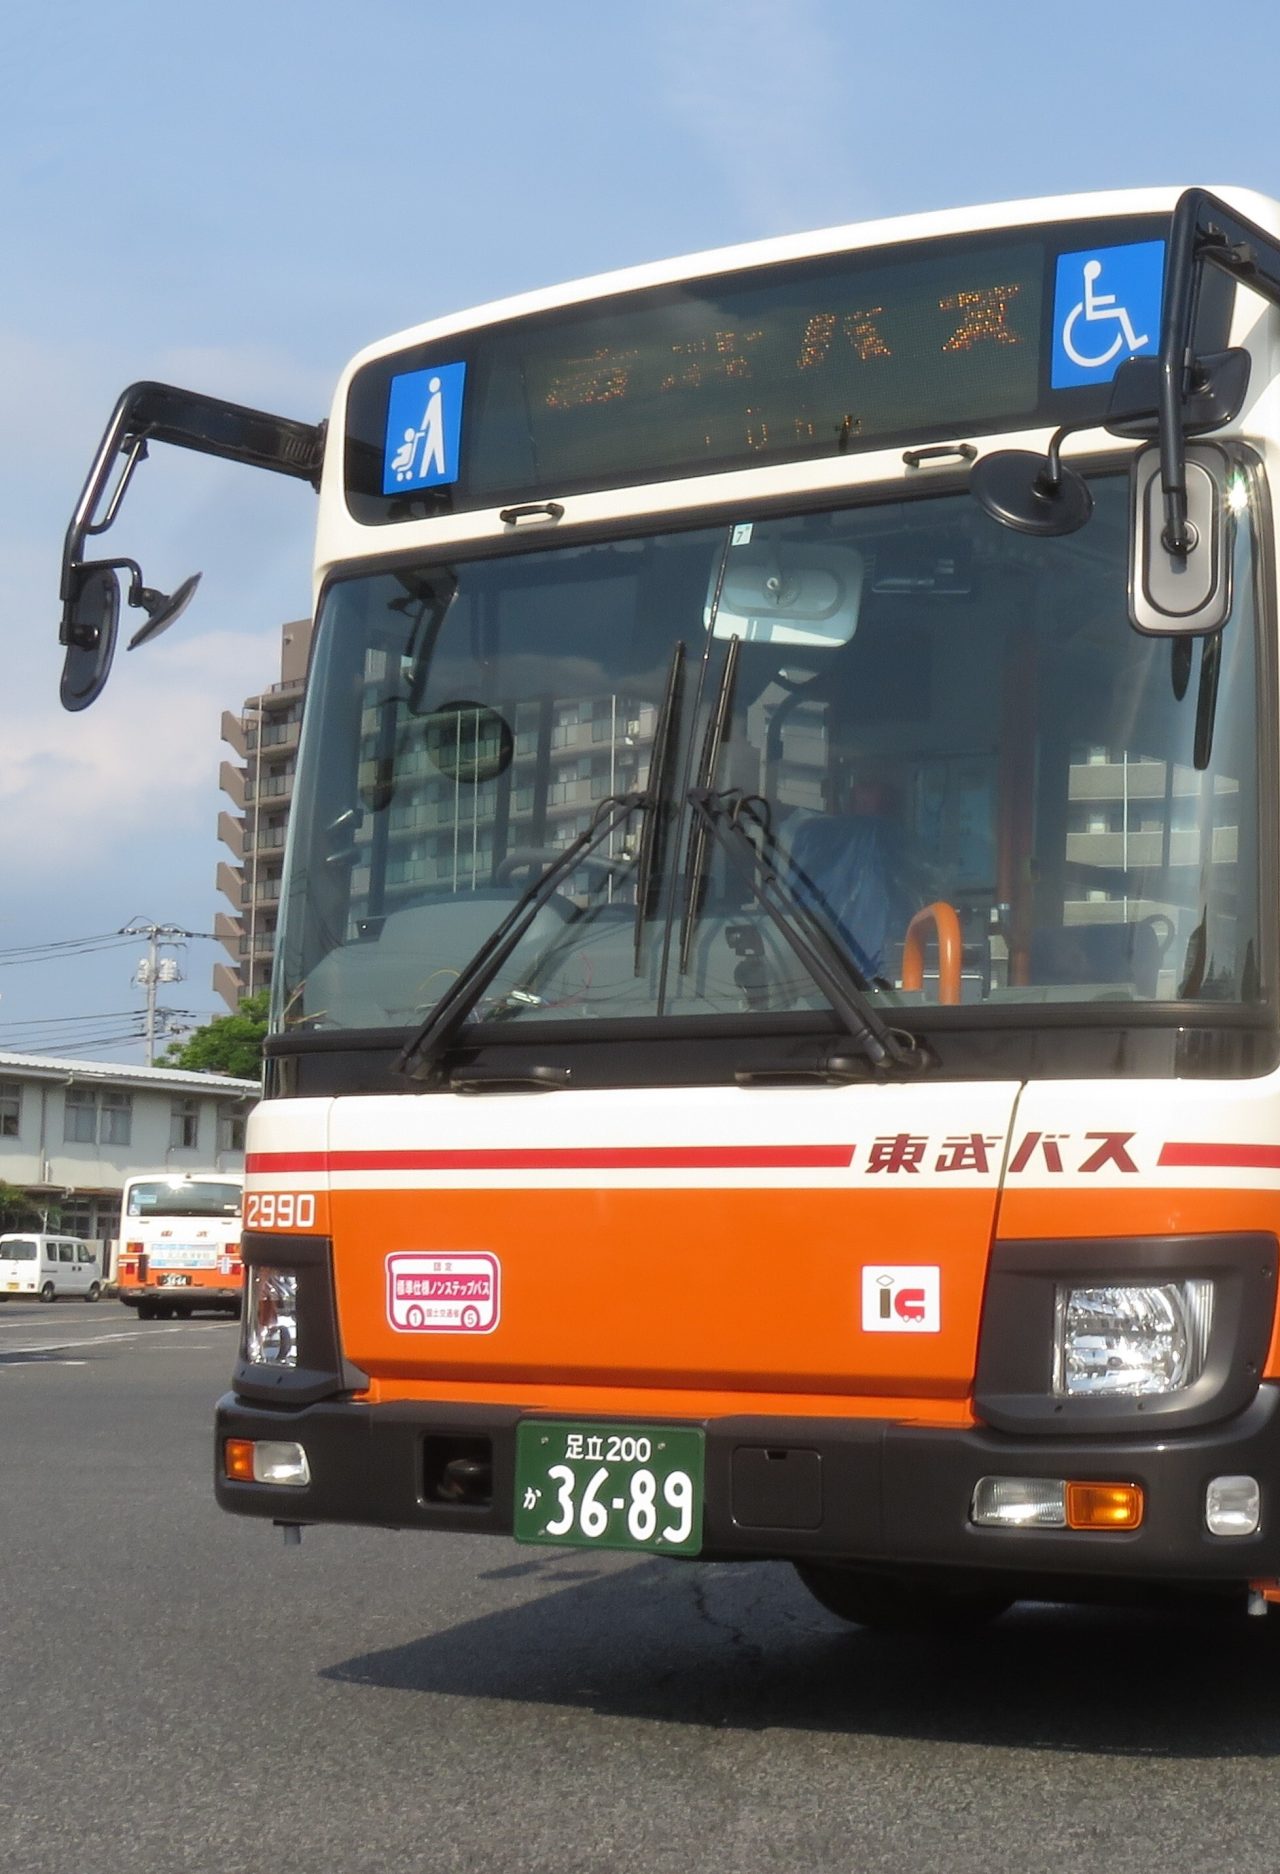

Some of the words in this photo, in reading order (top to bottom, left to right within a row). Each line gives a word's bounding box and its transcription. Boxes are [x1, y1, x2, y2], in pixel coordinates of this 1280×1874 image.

[864, 1131, 1139, 1173] 東武バス
[247, 1194, 315, 1228] 2990
[397, 1279, 490, 1296] 標準仕様ノンステップバス
[523, 1486, 542, 1510] か
[546, 1464, 693, 1543] 36-89
